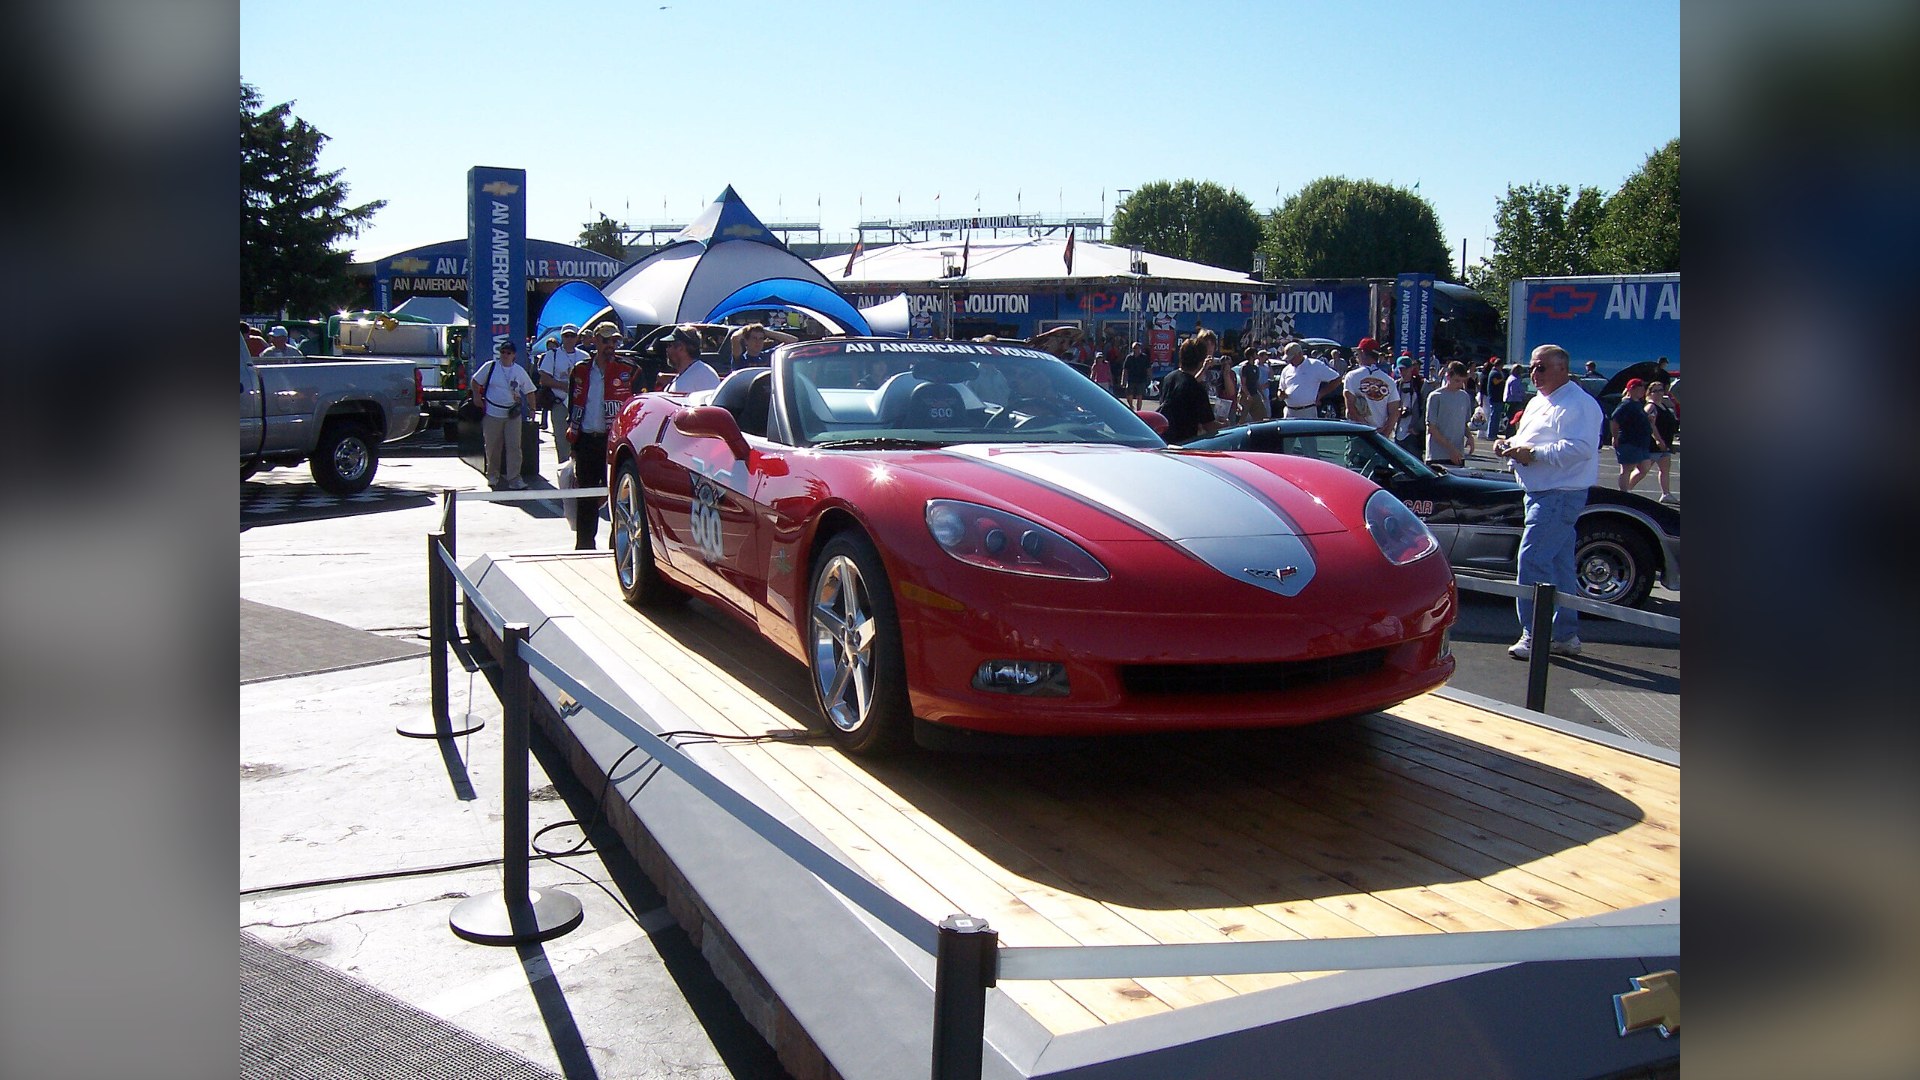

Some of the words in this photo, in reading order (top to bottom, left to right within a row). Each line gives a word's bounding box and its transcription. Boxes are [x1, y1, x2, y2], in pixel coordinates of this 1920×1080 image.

[491, 201, 510, 225] AN
[923, 218, 965, 231] AMERICAN
[436, 257, 457, 275] AN
[491, 228, 510, 309] AMERICAN
[393, 277, 410, 292] AN
[413, 277, 469, 292] AMERICAN
[857, 295, 874, 310] AN
[1146, 292, 1226, 313] AMERICAN
[1421, 289, 1429, 302] AN
[1604, 283, 1647, 320] AN
[1400, 303, 1410, 345] AMERICAN
[1419, 303, 1428, 345] AMERICAN
[845, 342, 875, 353] AN
[880, 343, 977, 356] AMERICAN
[929, 407, 952, 418] 500
[1403, 500, 1434, 514] CAR
[690, 498, 724, 560] 500
